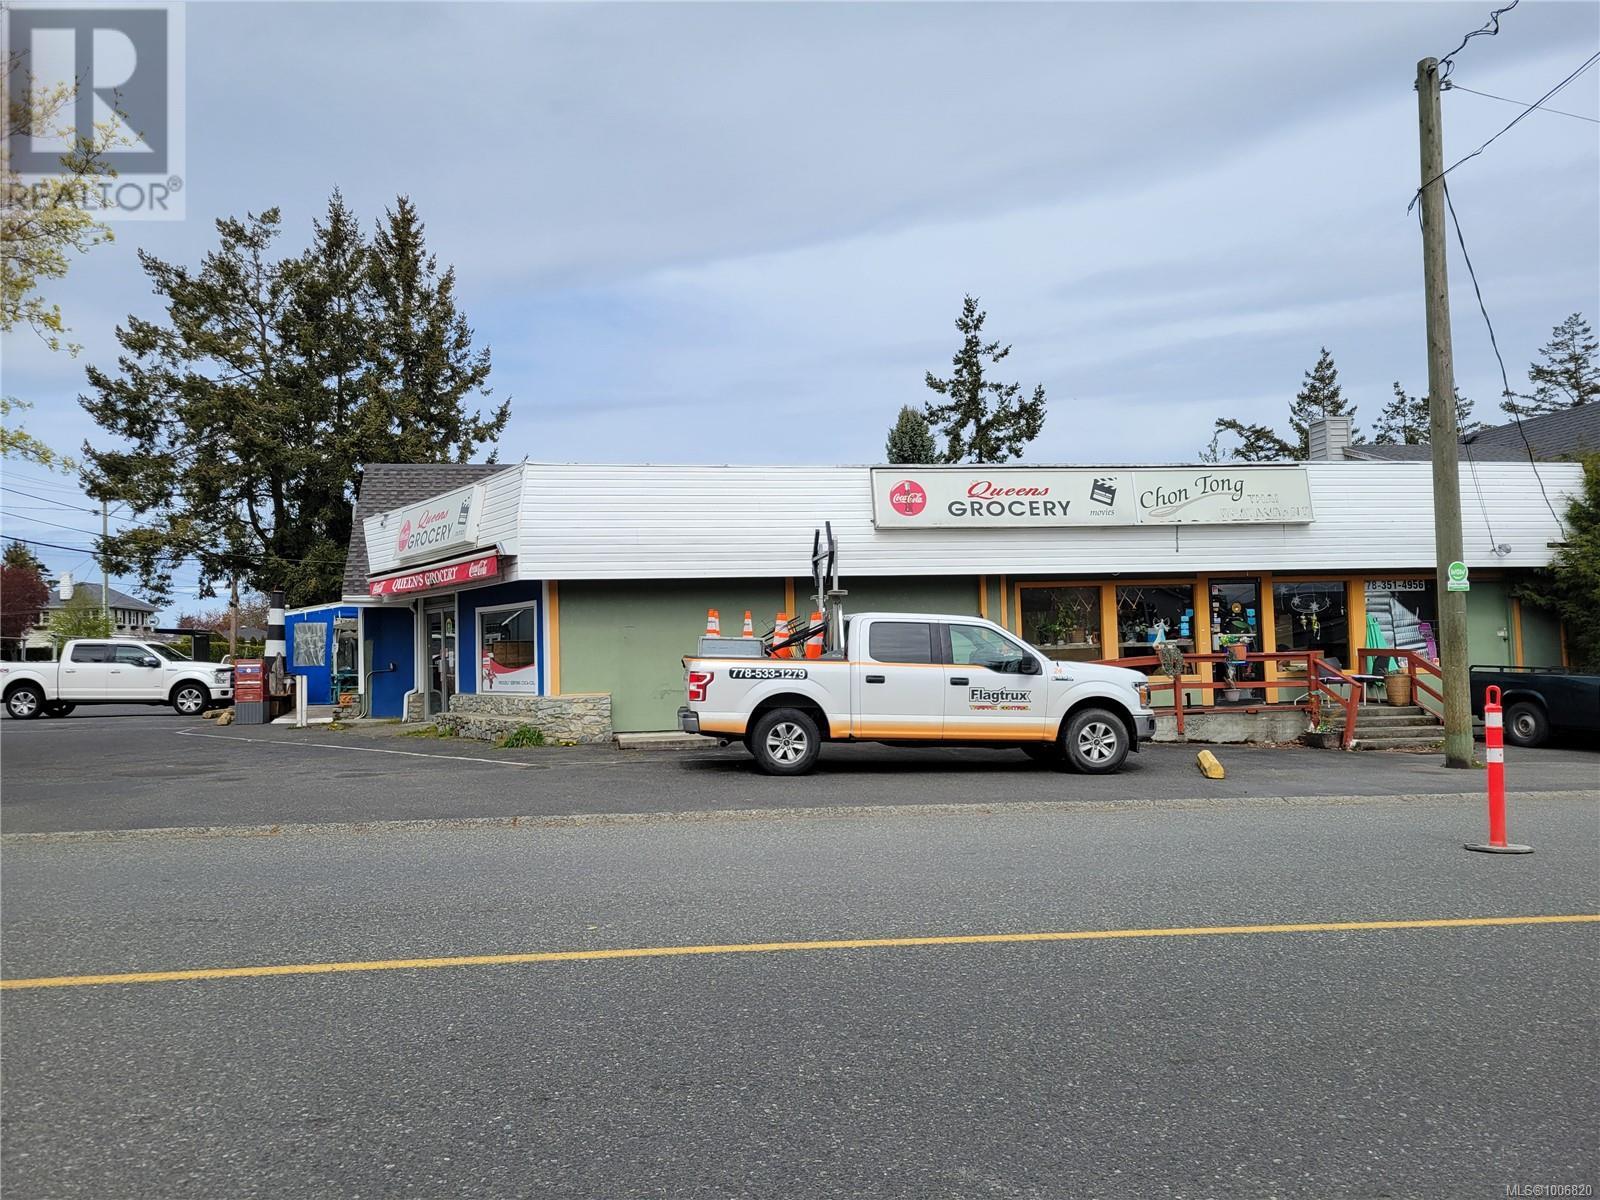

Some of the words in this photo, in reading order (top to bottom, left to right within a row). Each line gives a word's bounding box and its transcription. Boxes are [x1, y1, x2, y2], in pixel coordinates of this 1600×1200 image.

[967, 480, 1050, 499] Queens
[1140, 486, 1190, 509] Chon
[1195, 473, 1244, 501] Tong
[947, 500, 1071, 517] GROCERY
[1089, 508, 1115, 517] movies
[417, 510, 449, 529] Queens
[407, 522, 453, 549] GROCERY
[392, 574, 424, 592] QUEEN'S
[425, 567, 458, 585] GROCERY
[731, 668, 805, 679] 778-533-1279
[970, 689, 1027, 703] Flagtrux
